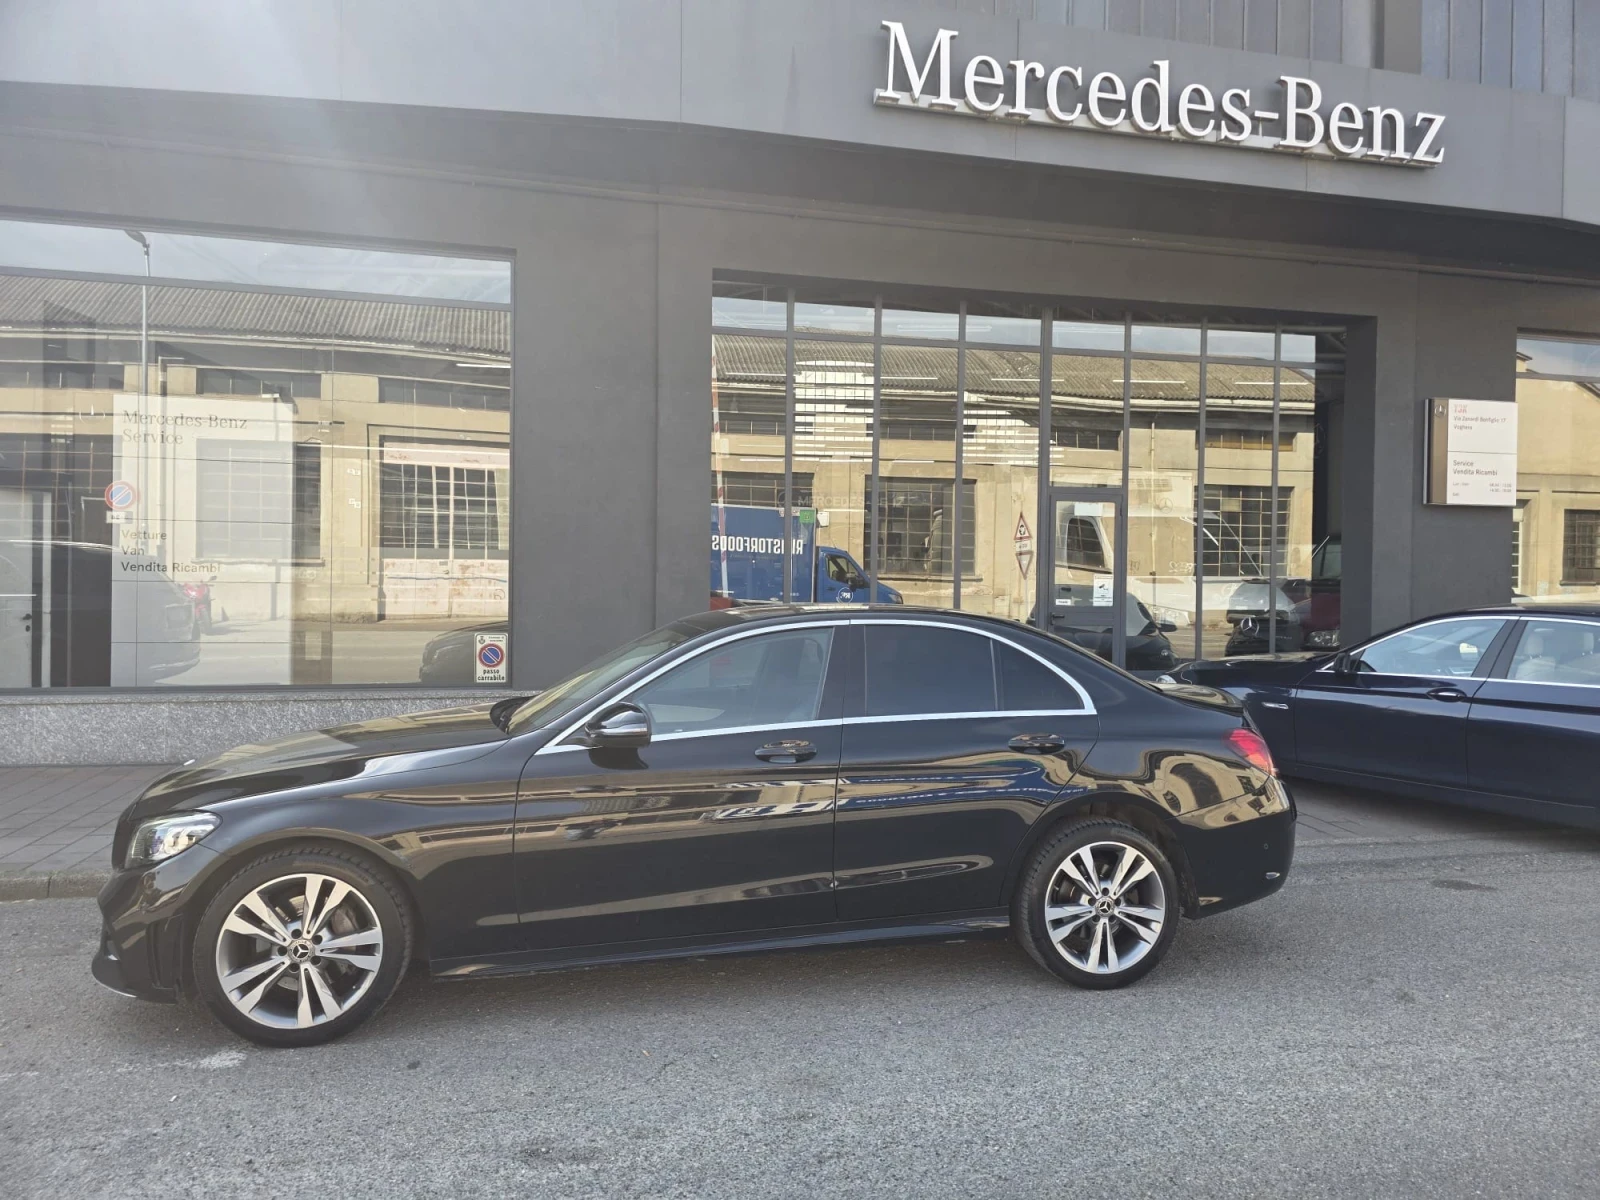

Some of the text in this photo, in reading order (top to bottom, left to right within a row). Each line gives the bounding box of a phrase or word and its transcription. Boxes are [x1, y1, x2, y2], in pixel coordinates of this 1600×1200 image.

[879, 20, 1447, 164] Mercedes-Benz
[122, 410, 248, 430] Mercedes-Benz
[122, 428, 184, 445] Service
[121, 529, 167, 540] Vetture
[121, 545, 145, 556] Van
[121, 562, 221, 573] Vendita Ricambi
